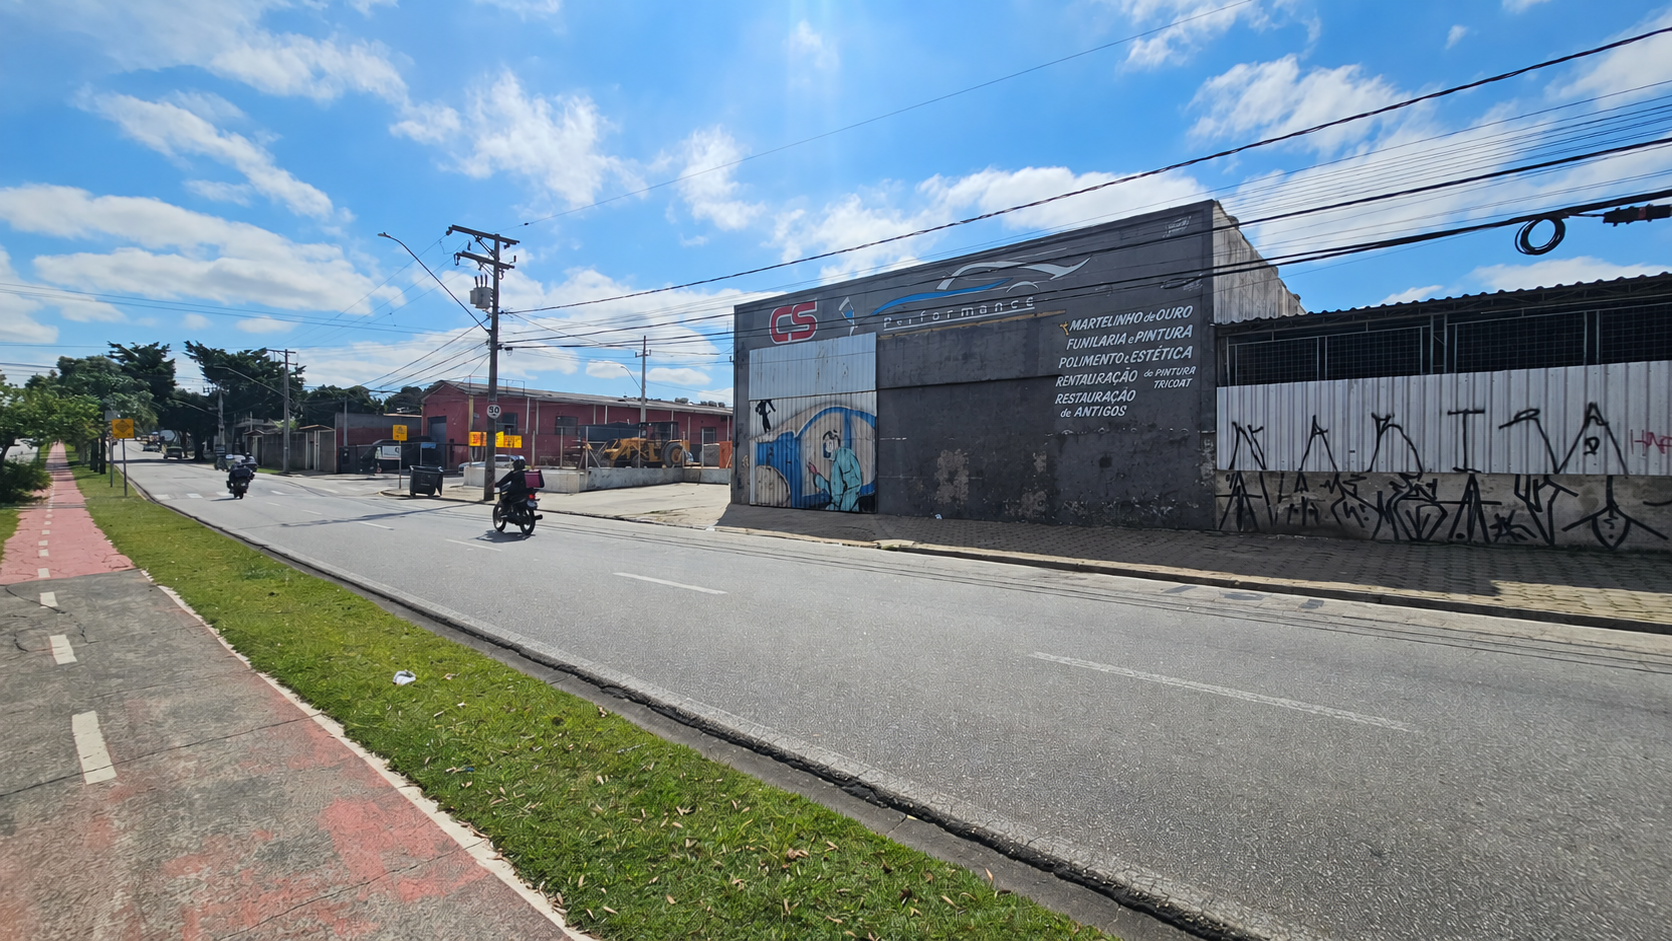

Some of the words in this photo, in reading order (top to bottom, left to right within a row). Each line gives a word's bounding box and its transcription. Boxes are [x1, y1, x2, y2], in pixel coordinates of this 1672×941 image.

[769, 298, 818, 345] CS
[1069, 312, 1143, 331] MARTELINHO
[1144, 312, 1155, 322] de
[1155, 305, 1194, 320] OURO
[1066, 332, 1127, 350] FUNILARIA
[1128, 335, 1134, 344] e
[1134, 324, 1194, 343] PINTURA
[1058, 352, 1125, 369] POLIMENTO
[1130, 344, 1194, 363] ESTÉTICA
[1154, 366, 1196, 377] PINTURA
[1153, 378, 1192, 389] TRICOAT
[1055, 386, 1137, 405] RESTAURAÇÃO
[1060, 408, 1072, 418] de
[1074, 405, 1127, 418] ANTIGOS
